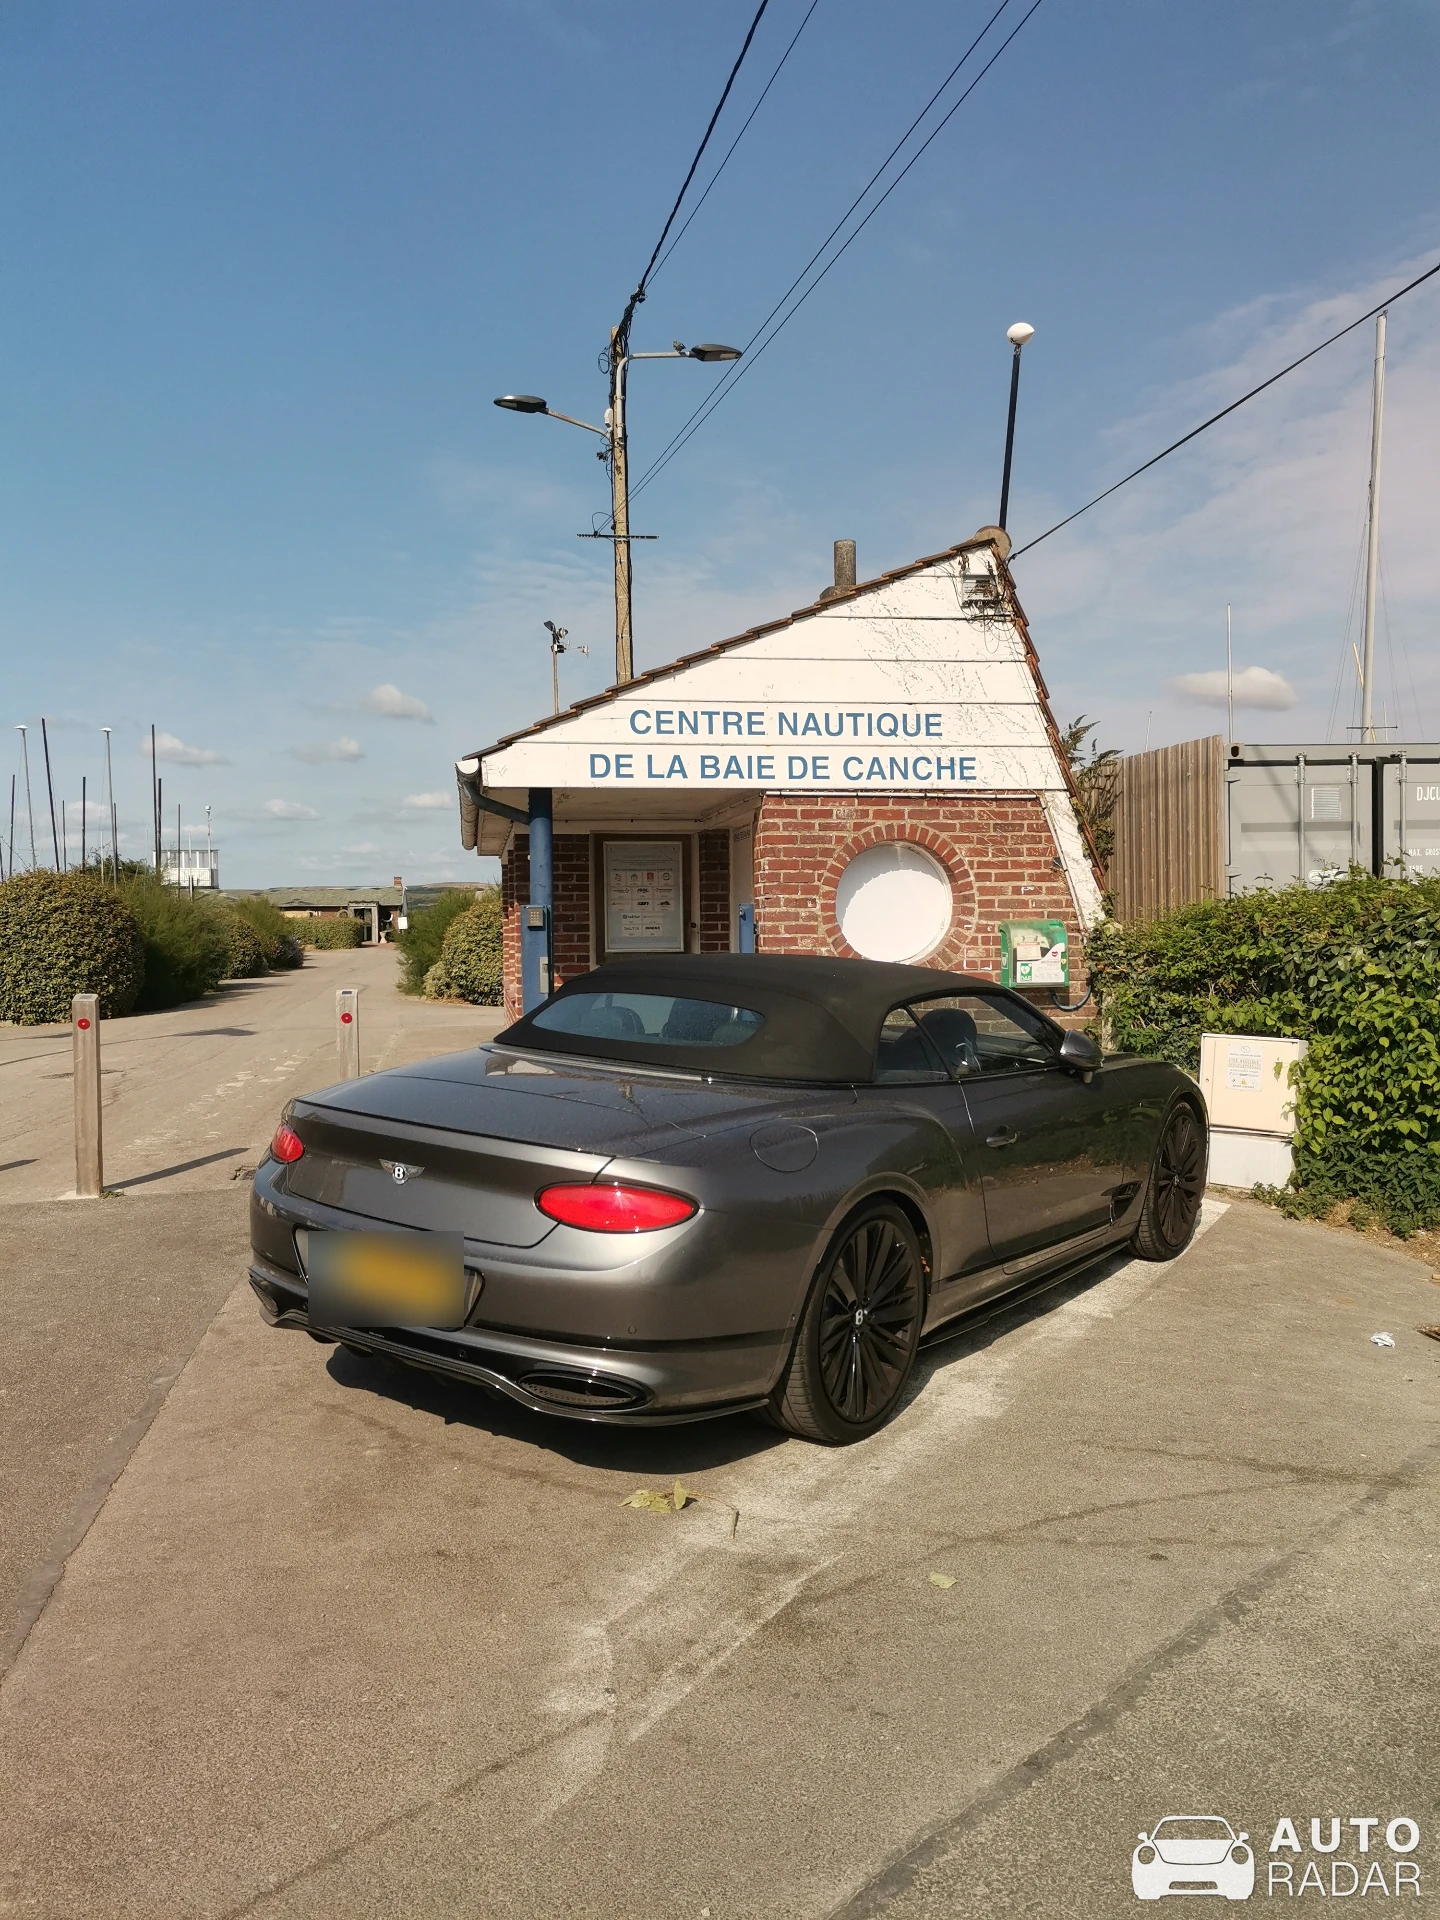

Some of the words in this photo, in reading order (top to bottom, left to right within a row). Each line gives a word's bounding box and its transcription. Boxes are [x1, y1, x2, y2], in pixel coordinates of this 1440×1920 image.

[629, 709, 764, 736] CENTRE
[778, 712, 942, 738] NAUTIQUE
[589, 753, 633, 779] DE
[647, 754, 687, 779] LA
[700, 755, 774, 780] BAIE
[787, 756, 829, 780] DE
[843, 756, 976, 781] CANCHE
[395, 1166, 404, 1180] B
[855, 1308, 864, 1325] B
